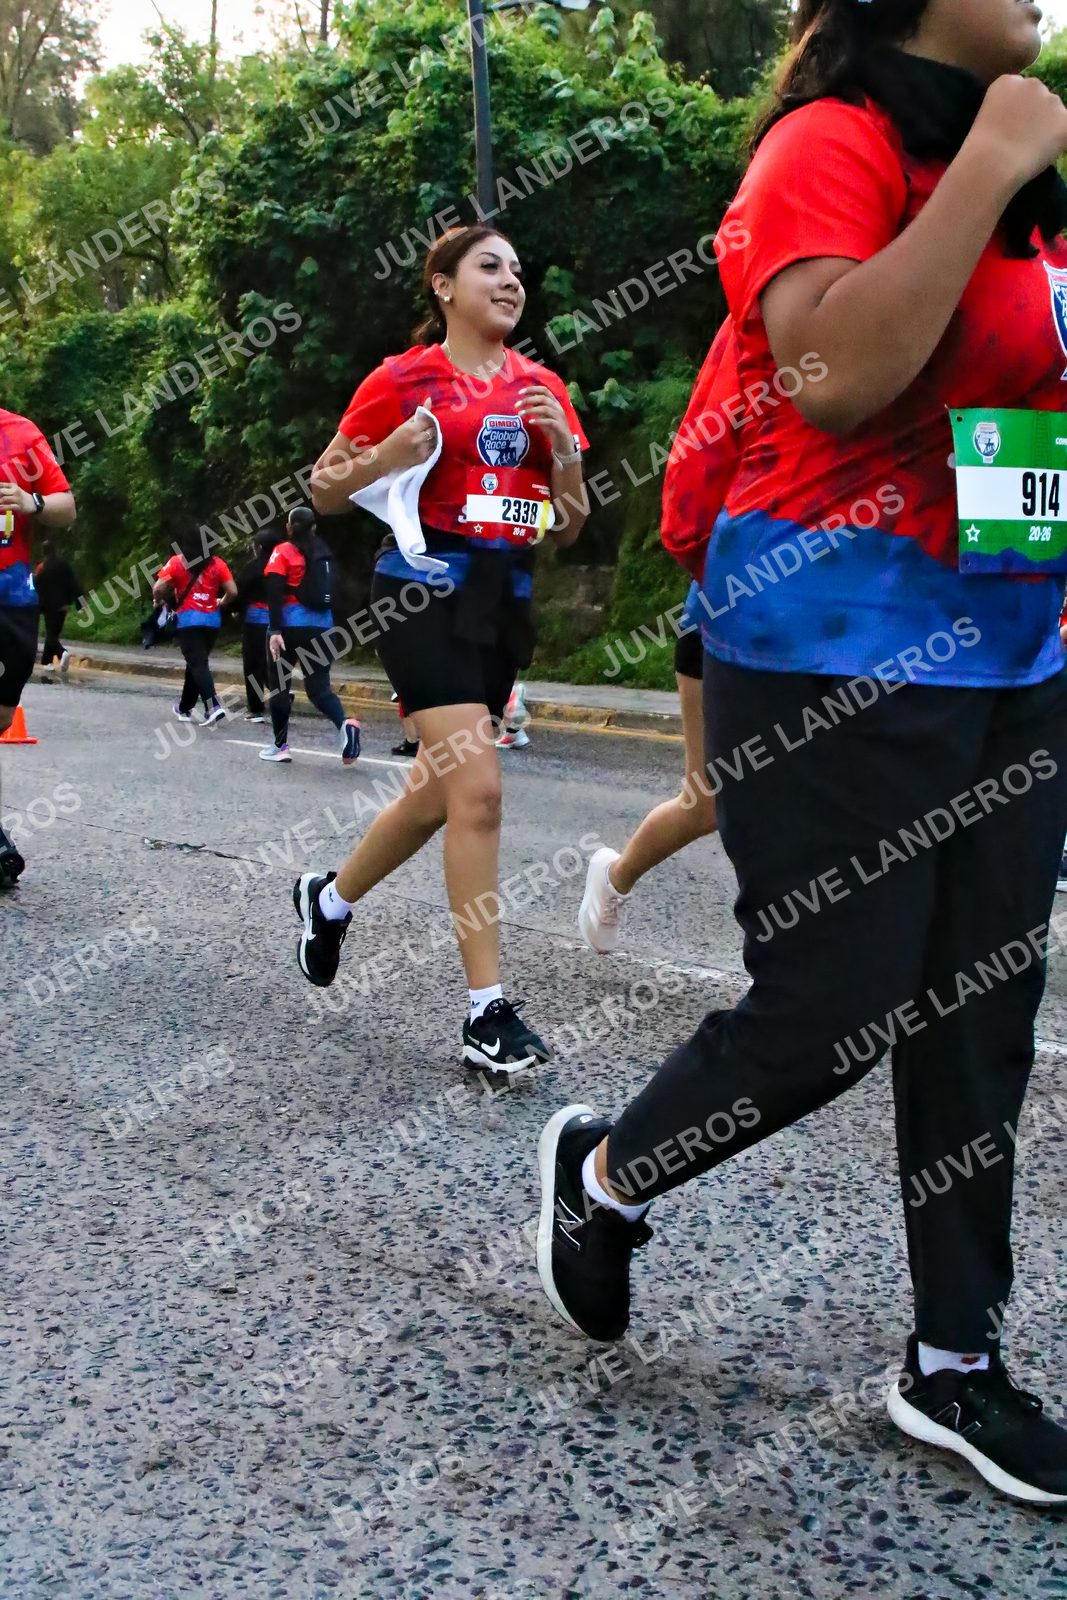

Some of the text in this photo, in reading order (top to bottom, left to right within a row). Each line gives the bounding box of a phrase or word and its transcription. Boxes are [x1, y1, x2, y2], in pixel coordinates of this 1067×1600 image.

[490, 430, 517, 441] Global
[485, 440, 507, 450] Race
[1022, 472, 1060, 517] 914
[502, 499, 538, 525] 2338
